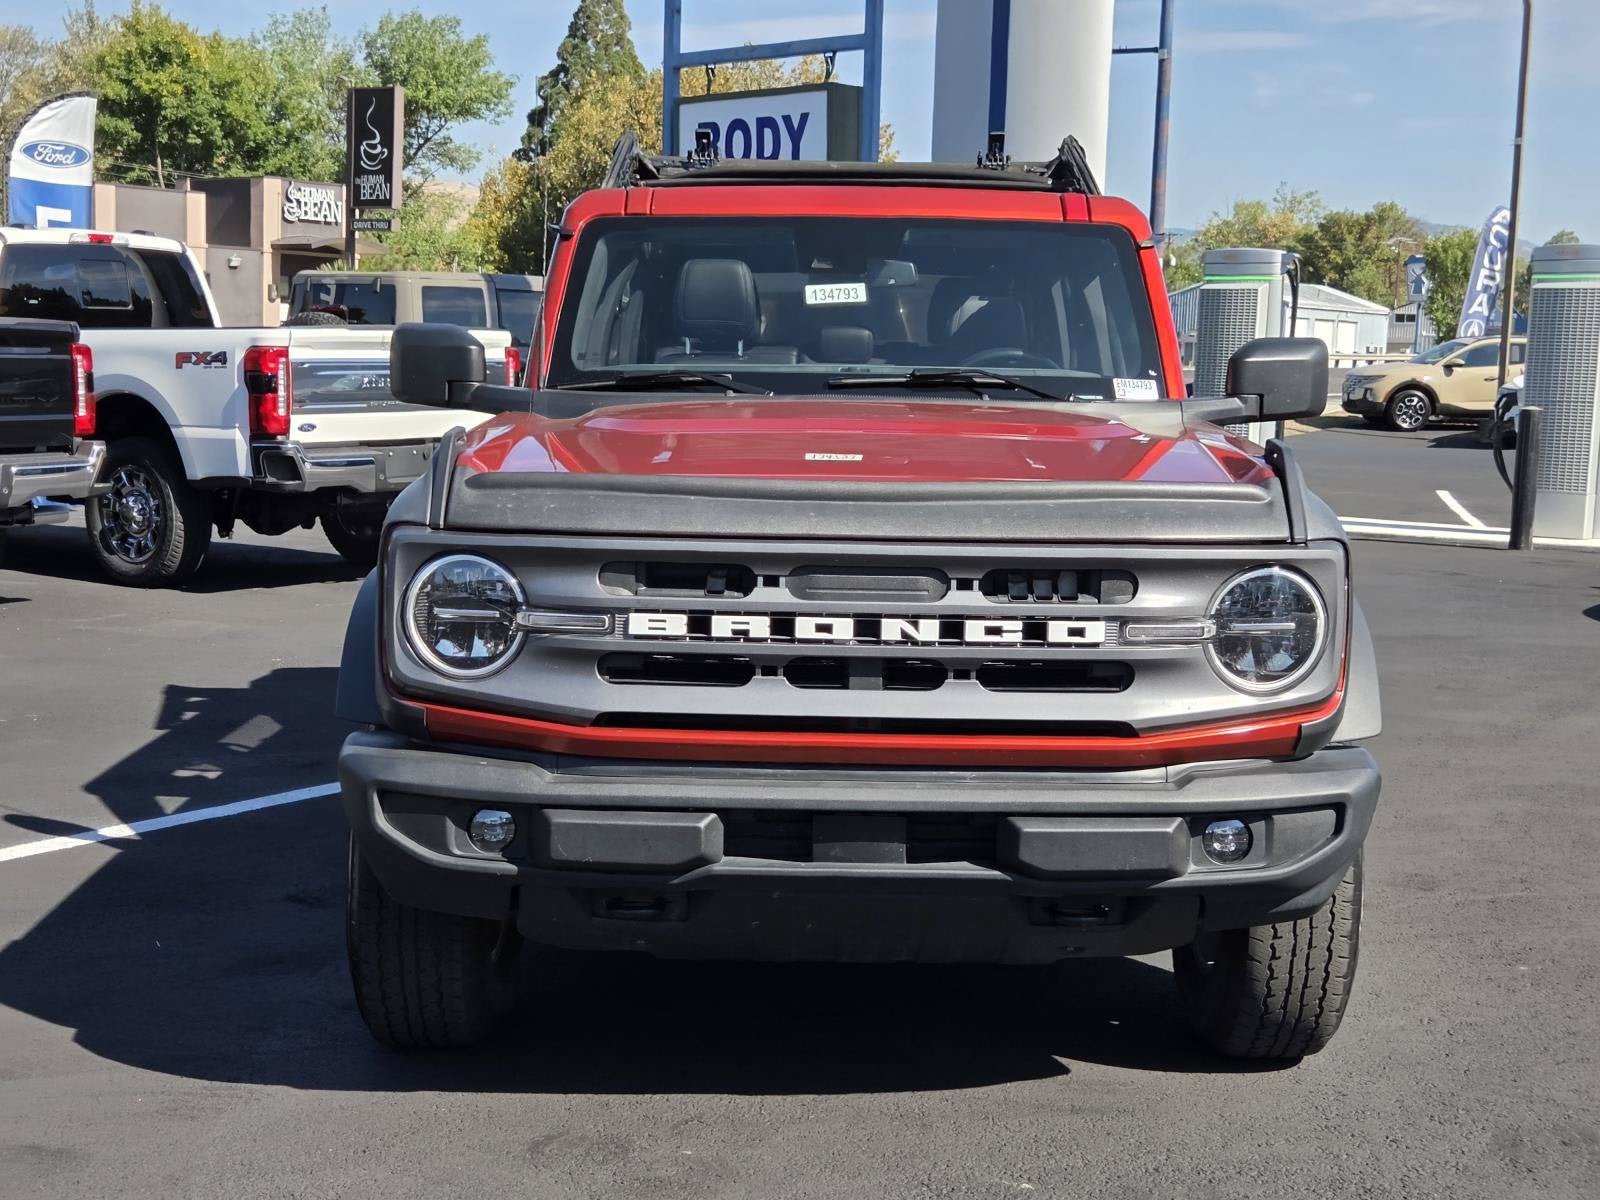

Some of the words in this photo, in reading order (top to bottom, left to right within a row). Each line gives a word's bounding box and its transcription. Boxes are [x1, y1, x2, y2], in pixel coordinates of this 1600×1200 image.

[34, 143, 76, 164] Ford
[360, 174, 385, 184] HUMAN
[301, 187, 335, 201] HUMAN
[360, 183, 390, 200] BEAN
[300, 200, 342, 222] BEAN
[354, 221, 371, 229] DRIVE
[372, 221, 389, 229] THRU
[812, 287, 859, 301] 134793
[175, 351, 227, 369] FX4
[628, 612, 1106, 643] BRONCO
